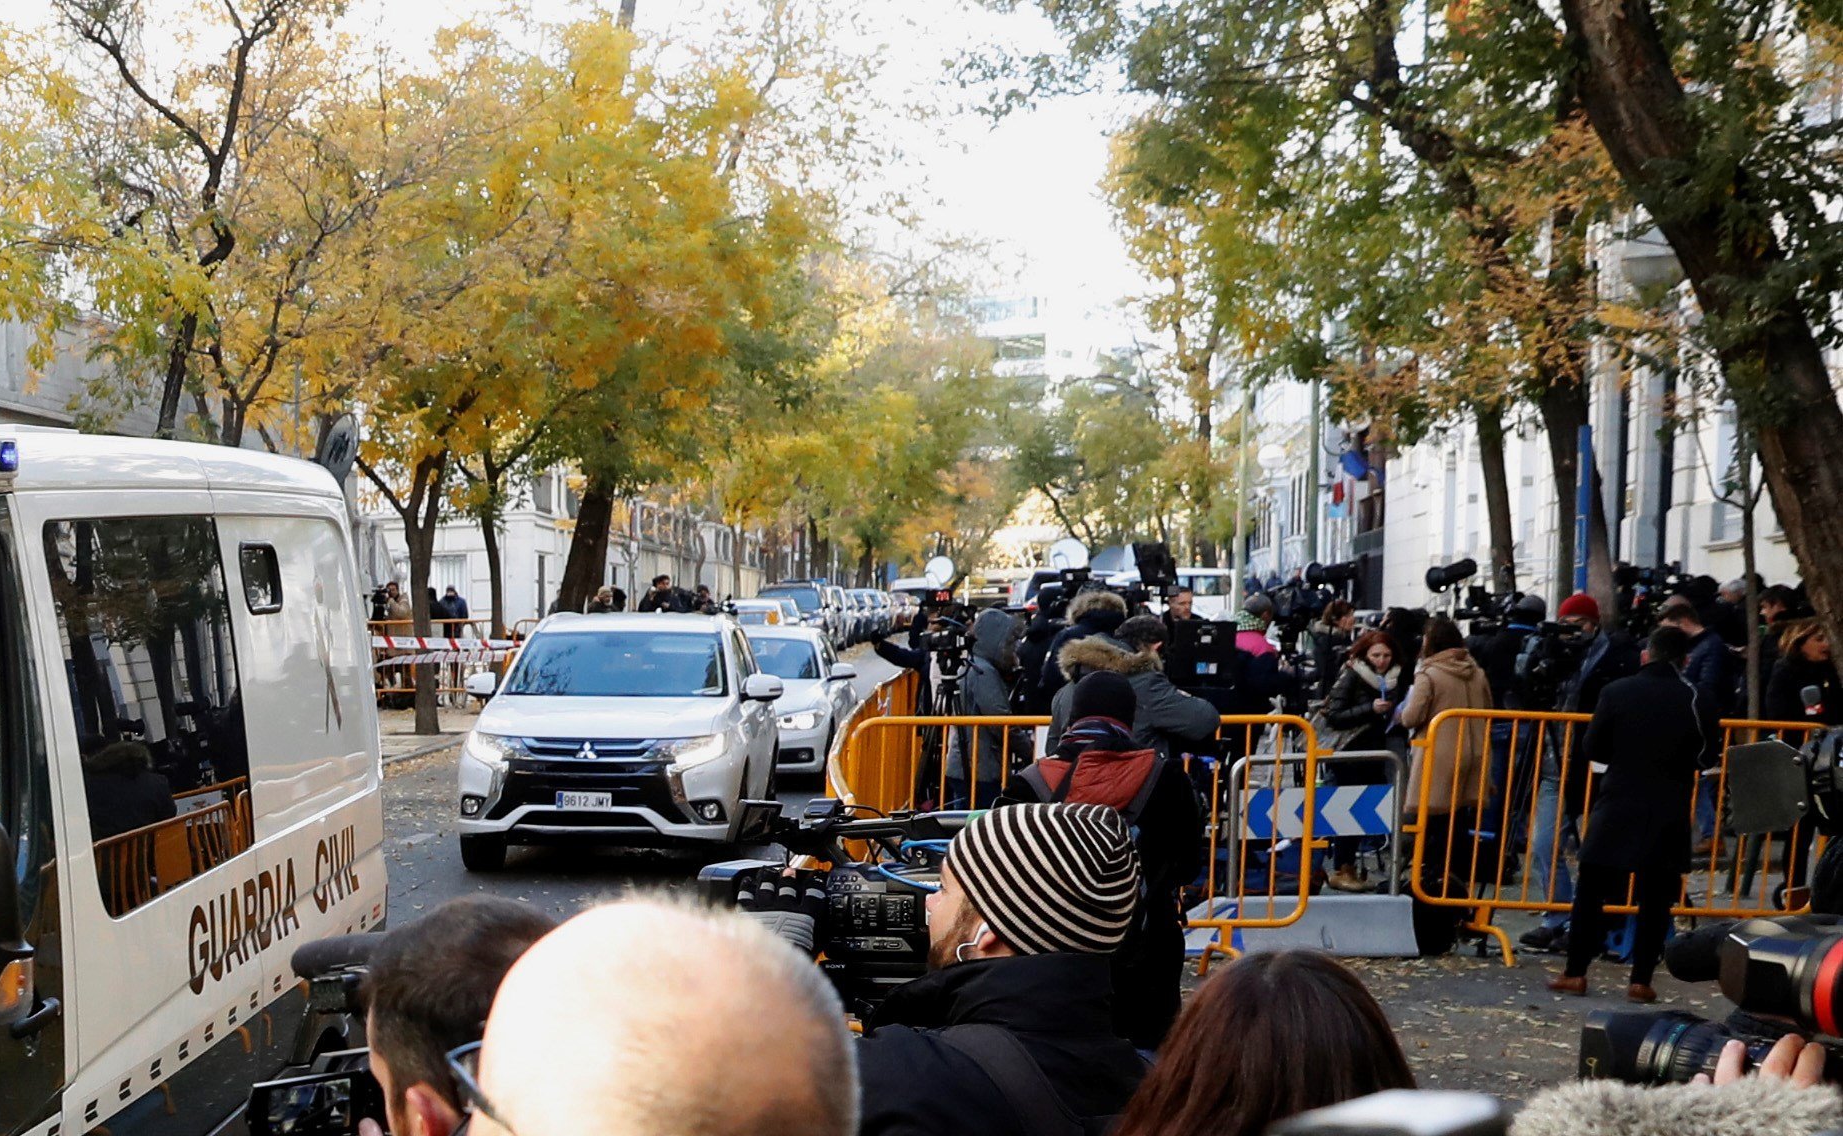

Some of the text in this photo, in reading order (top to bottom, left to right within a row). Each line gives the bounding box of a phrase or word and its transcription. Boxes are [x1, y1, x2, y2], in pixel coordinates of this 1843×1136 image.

[563, 795, 611, 807] 9612 JMY
[188, 824, 360, 996] GUARDIA CIVIL
